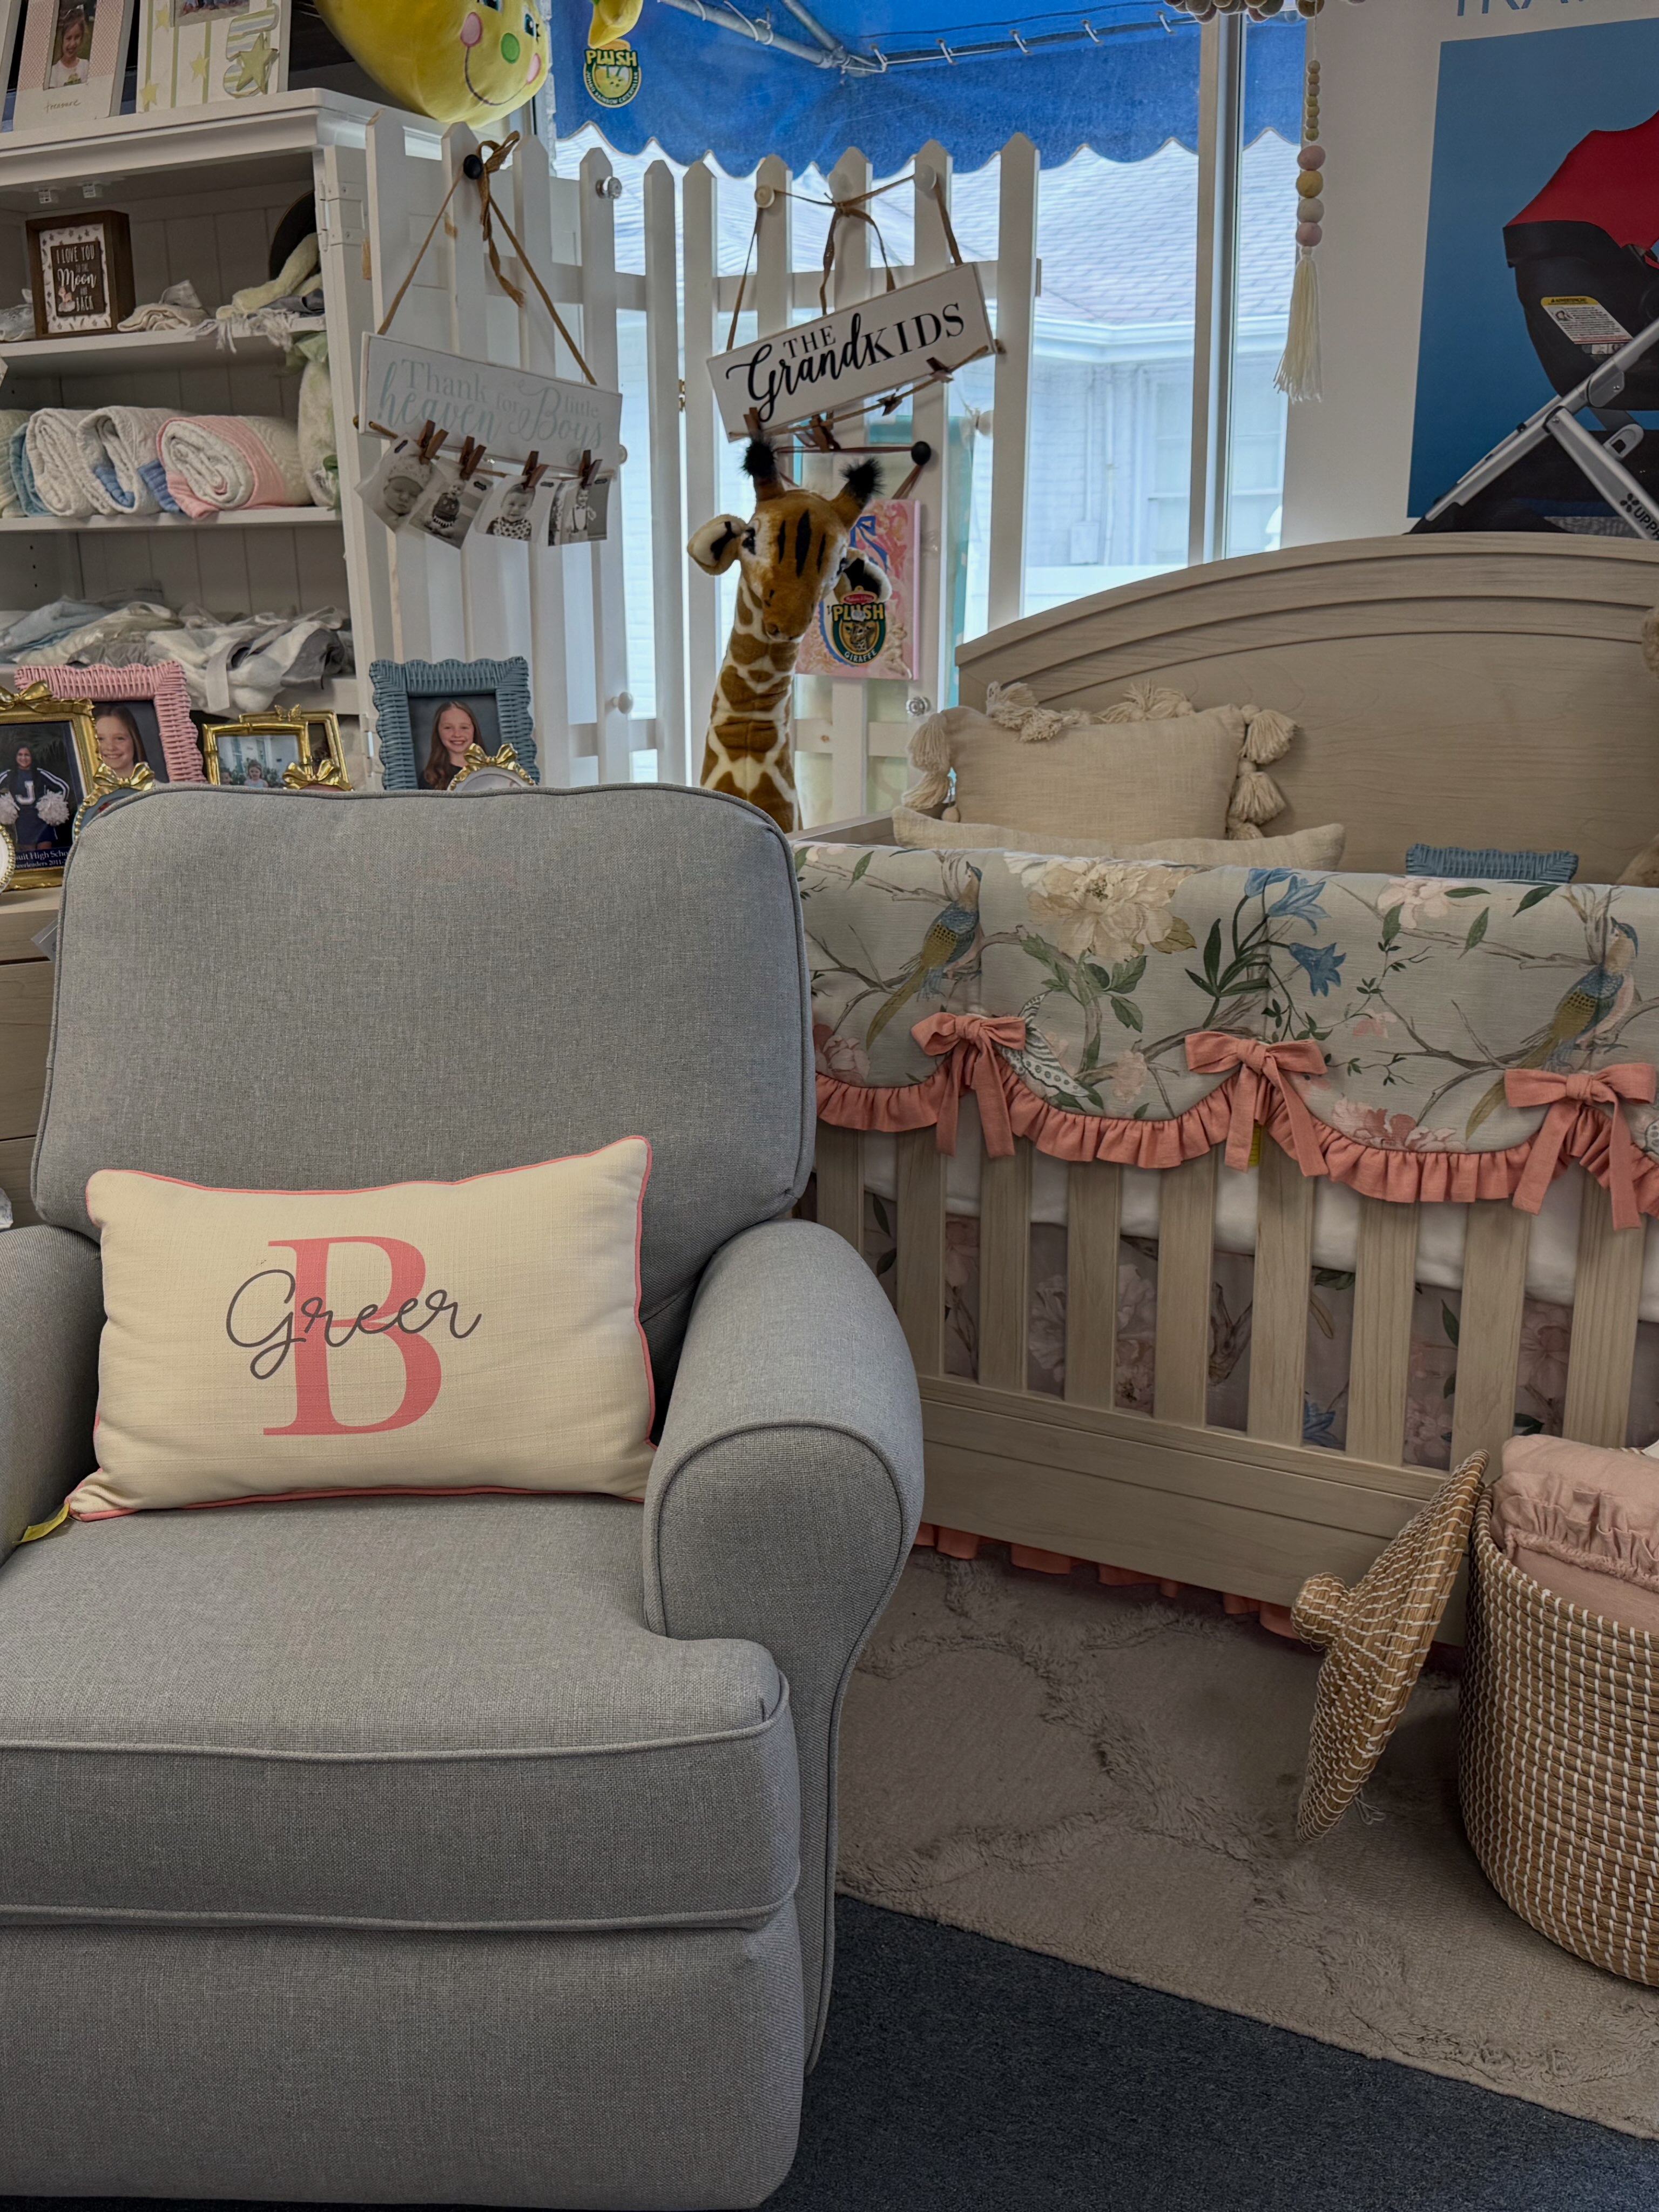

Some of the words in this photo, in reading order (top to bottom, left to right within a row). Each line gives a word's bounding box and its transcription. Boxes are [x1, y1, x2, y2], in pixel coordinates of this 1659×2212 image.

[585, 50, 638, 66] PLUSH
[56, 249, 60, 264] I
[61, 246, 79, 264] LOVE
[81, 244, 95, 261] YOU
[57, 268, 97, 292] Moon
[76, 295, 94, 312] BACK
[783, 325, 837, 359] THE
[401, 358, 487, 402] Thank
[377, 361, 500, 444] heaven
[496, 393, 520, 414] for
[564, 393, 600, 419] little
[509, 379, 602, 466] Boys
[844, 649, 877, 663] GIRAFFE
[15, 780, 36, 805] J
[30, 850, 49, 860] High
[226, 1269, 482, 1380] Greer
[263, 1236, 442, 1435] B
